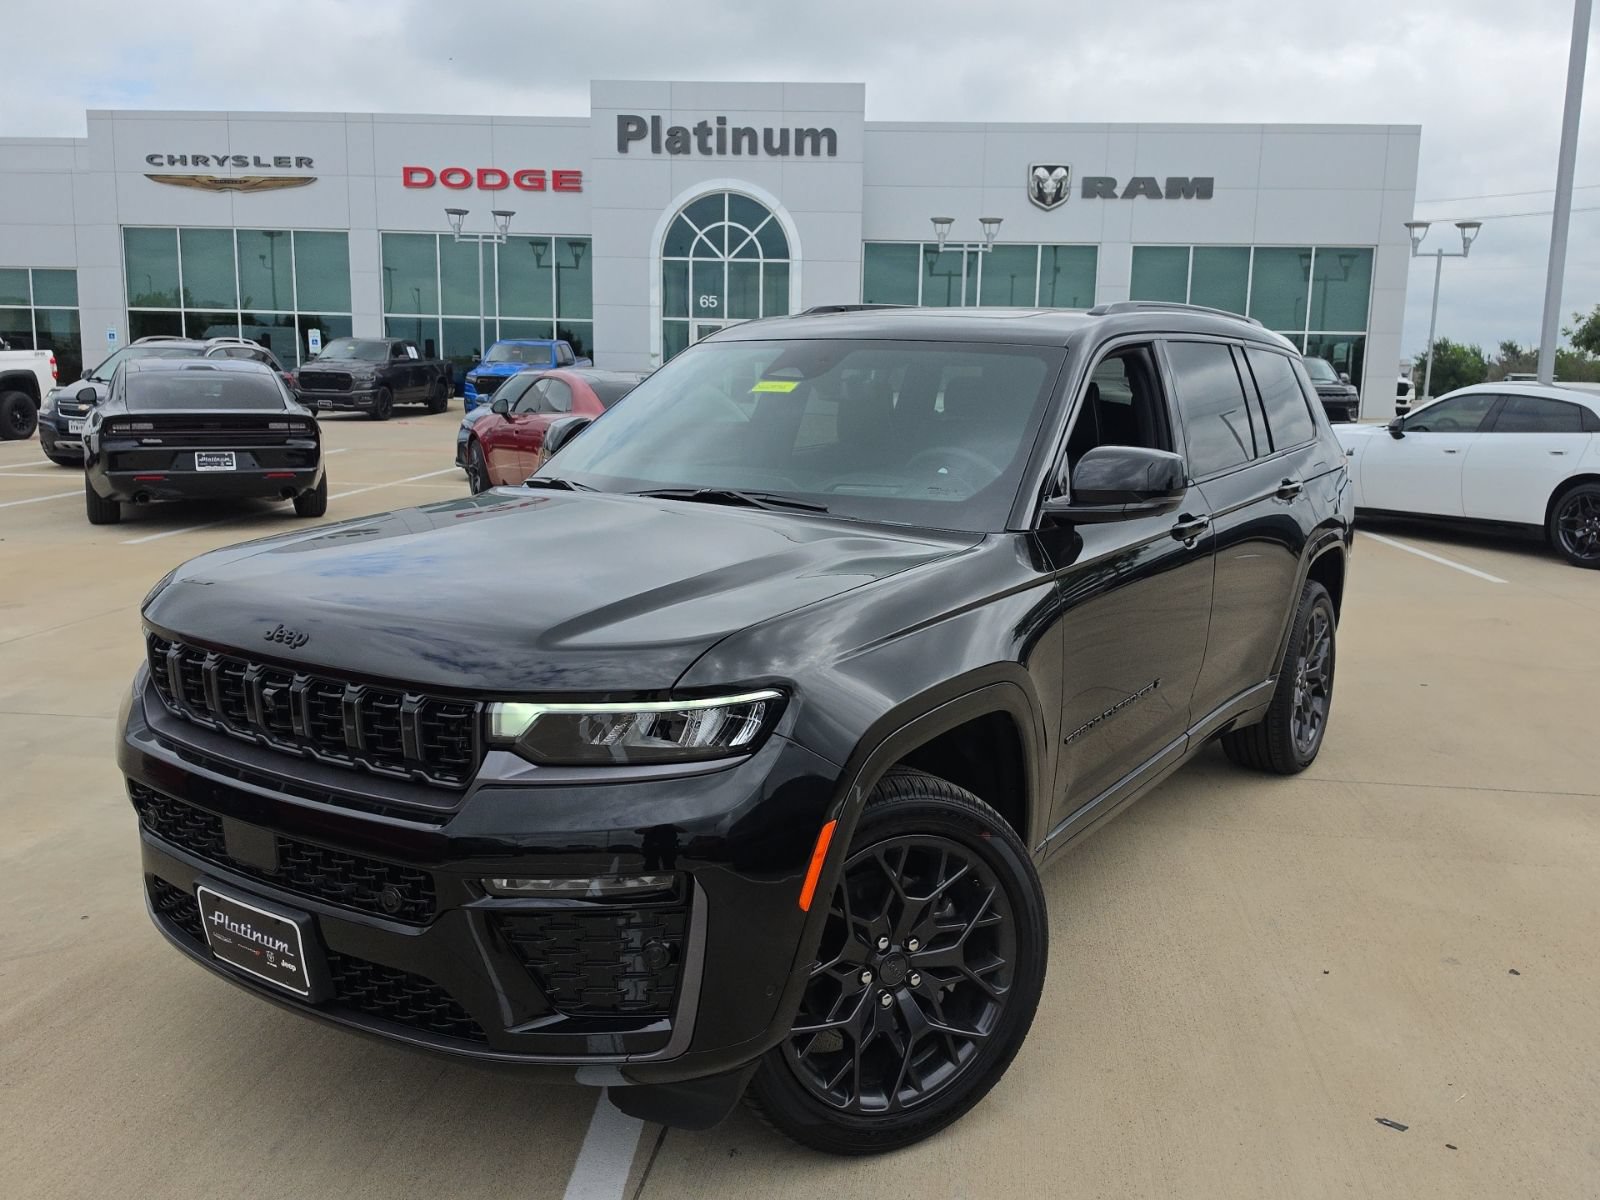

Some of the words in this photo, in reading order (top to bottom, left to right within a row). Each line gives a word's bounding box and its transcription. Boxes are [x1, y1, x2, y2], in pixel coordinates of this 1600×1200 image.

[616, 114, 838, 157] Platinum
[145, 154, 314, 169] CHRYSLER
[402, 166, 583, 193] DODGE
[1081, 176, 1214, 200] RAM
[699, 295, 718, 308] 65
[263, 623, 310, 650] Jeep
[208, 910, 295, 957] Platinum
[281, 959, 297, 972] Jeep
